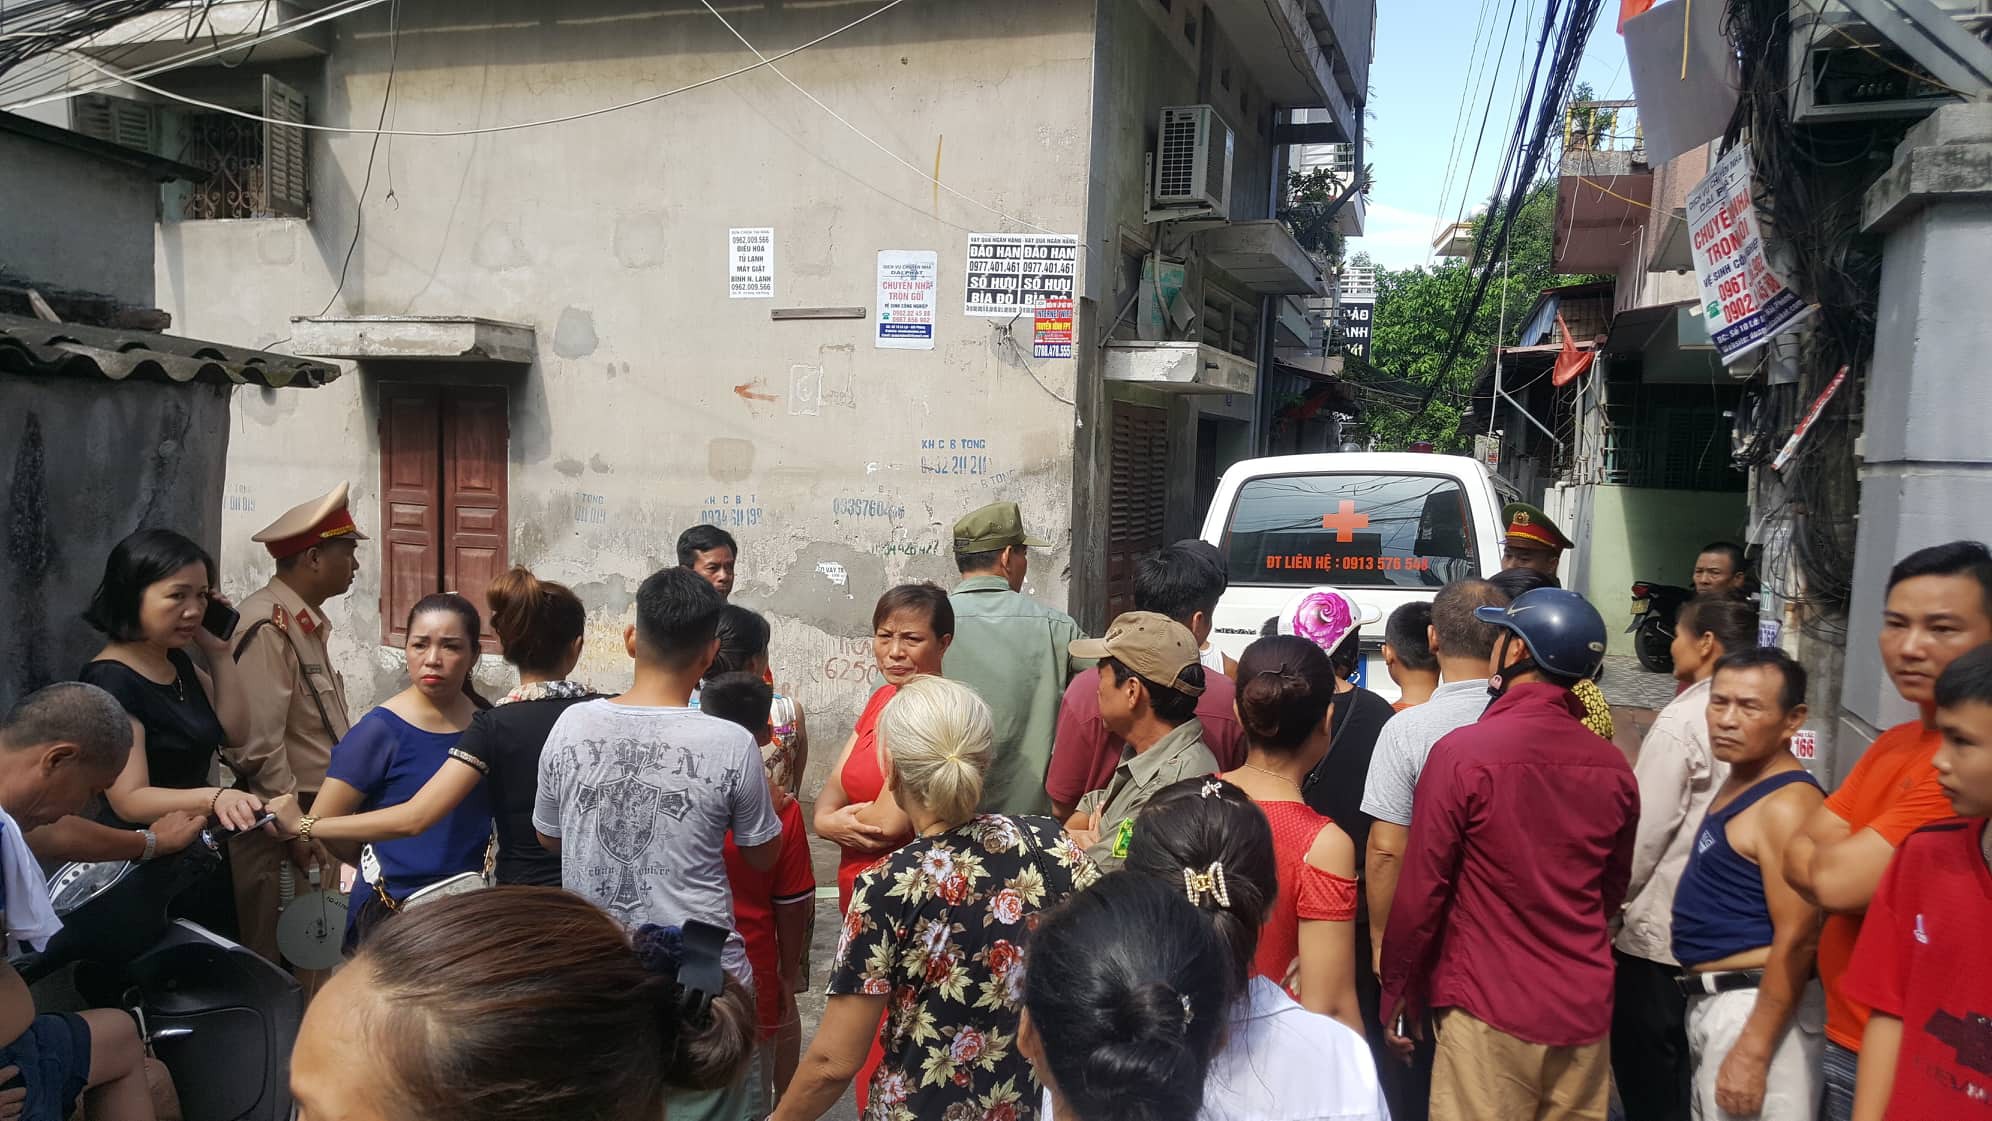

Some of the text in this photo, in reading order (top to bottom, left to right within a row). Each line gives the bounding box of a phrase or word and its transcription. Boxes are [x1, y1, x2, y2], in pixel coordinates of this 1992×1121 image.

[969, 260, 1020, 272] 0977.401.461
[1023, 261, 1074, 274] 0977.401.461
[1266, 555, 1282, 569] ĐT
[1285, 553, 1312, 569] LIÊN
[1315, 553, 1332, 572] HỆ
[1342, 556, 1374, 570] 0913
[1377, 556, 1401, 570] 576
